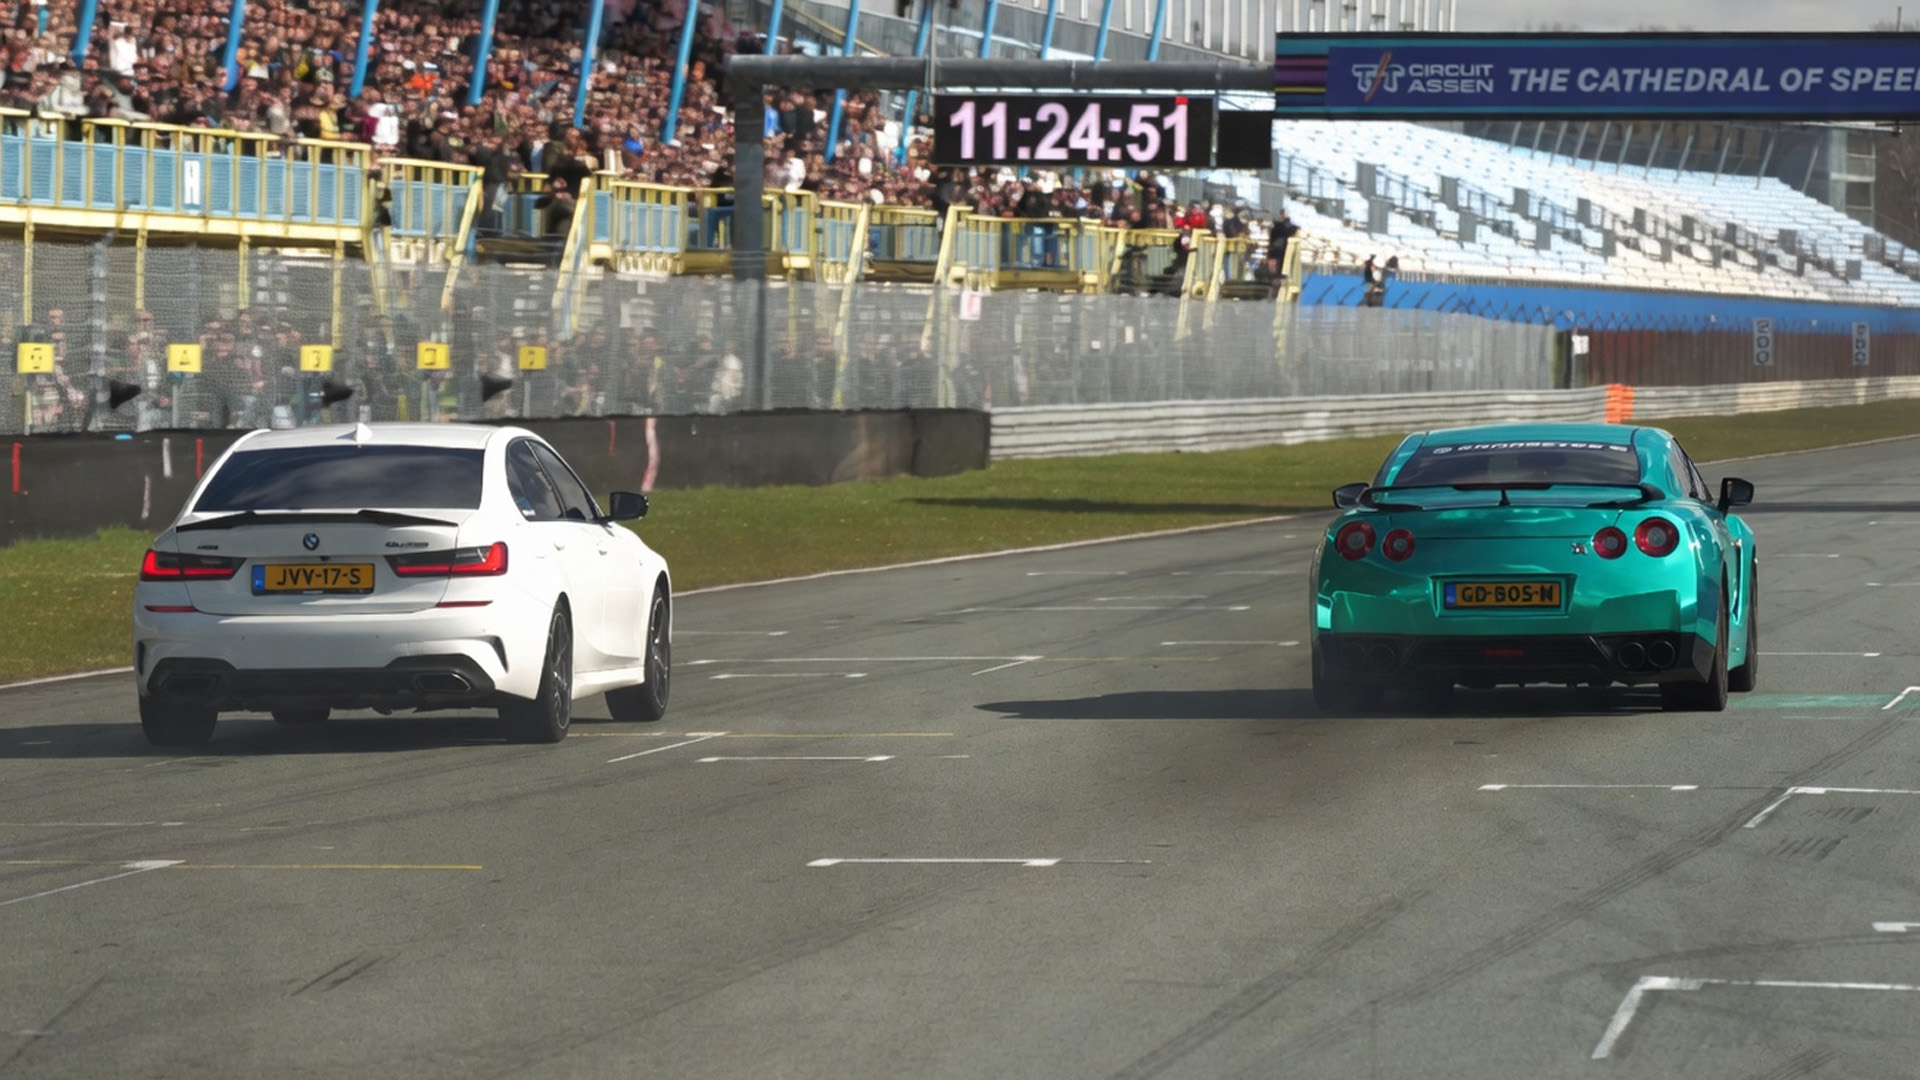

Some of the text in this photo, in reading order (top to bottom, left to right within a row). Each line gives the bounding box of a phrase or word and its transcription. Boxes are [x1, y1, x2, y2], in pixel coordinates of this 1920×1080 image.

[1408, 63, 1494, 77] CIRCUIT
[1407, 79, 1494, 93] ASSEN
[1508, 67, 1571, 92] THE
[1576, 67, 1770, 93] CATHEDRAL
[1779, 67, 1824, 93] OF
[950, 101, 1188, 162] 11:24:51
[276, 567, 361, 586] JVV-17-S
